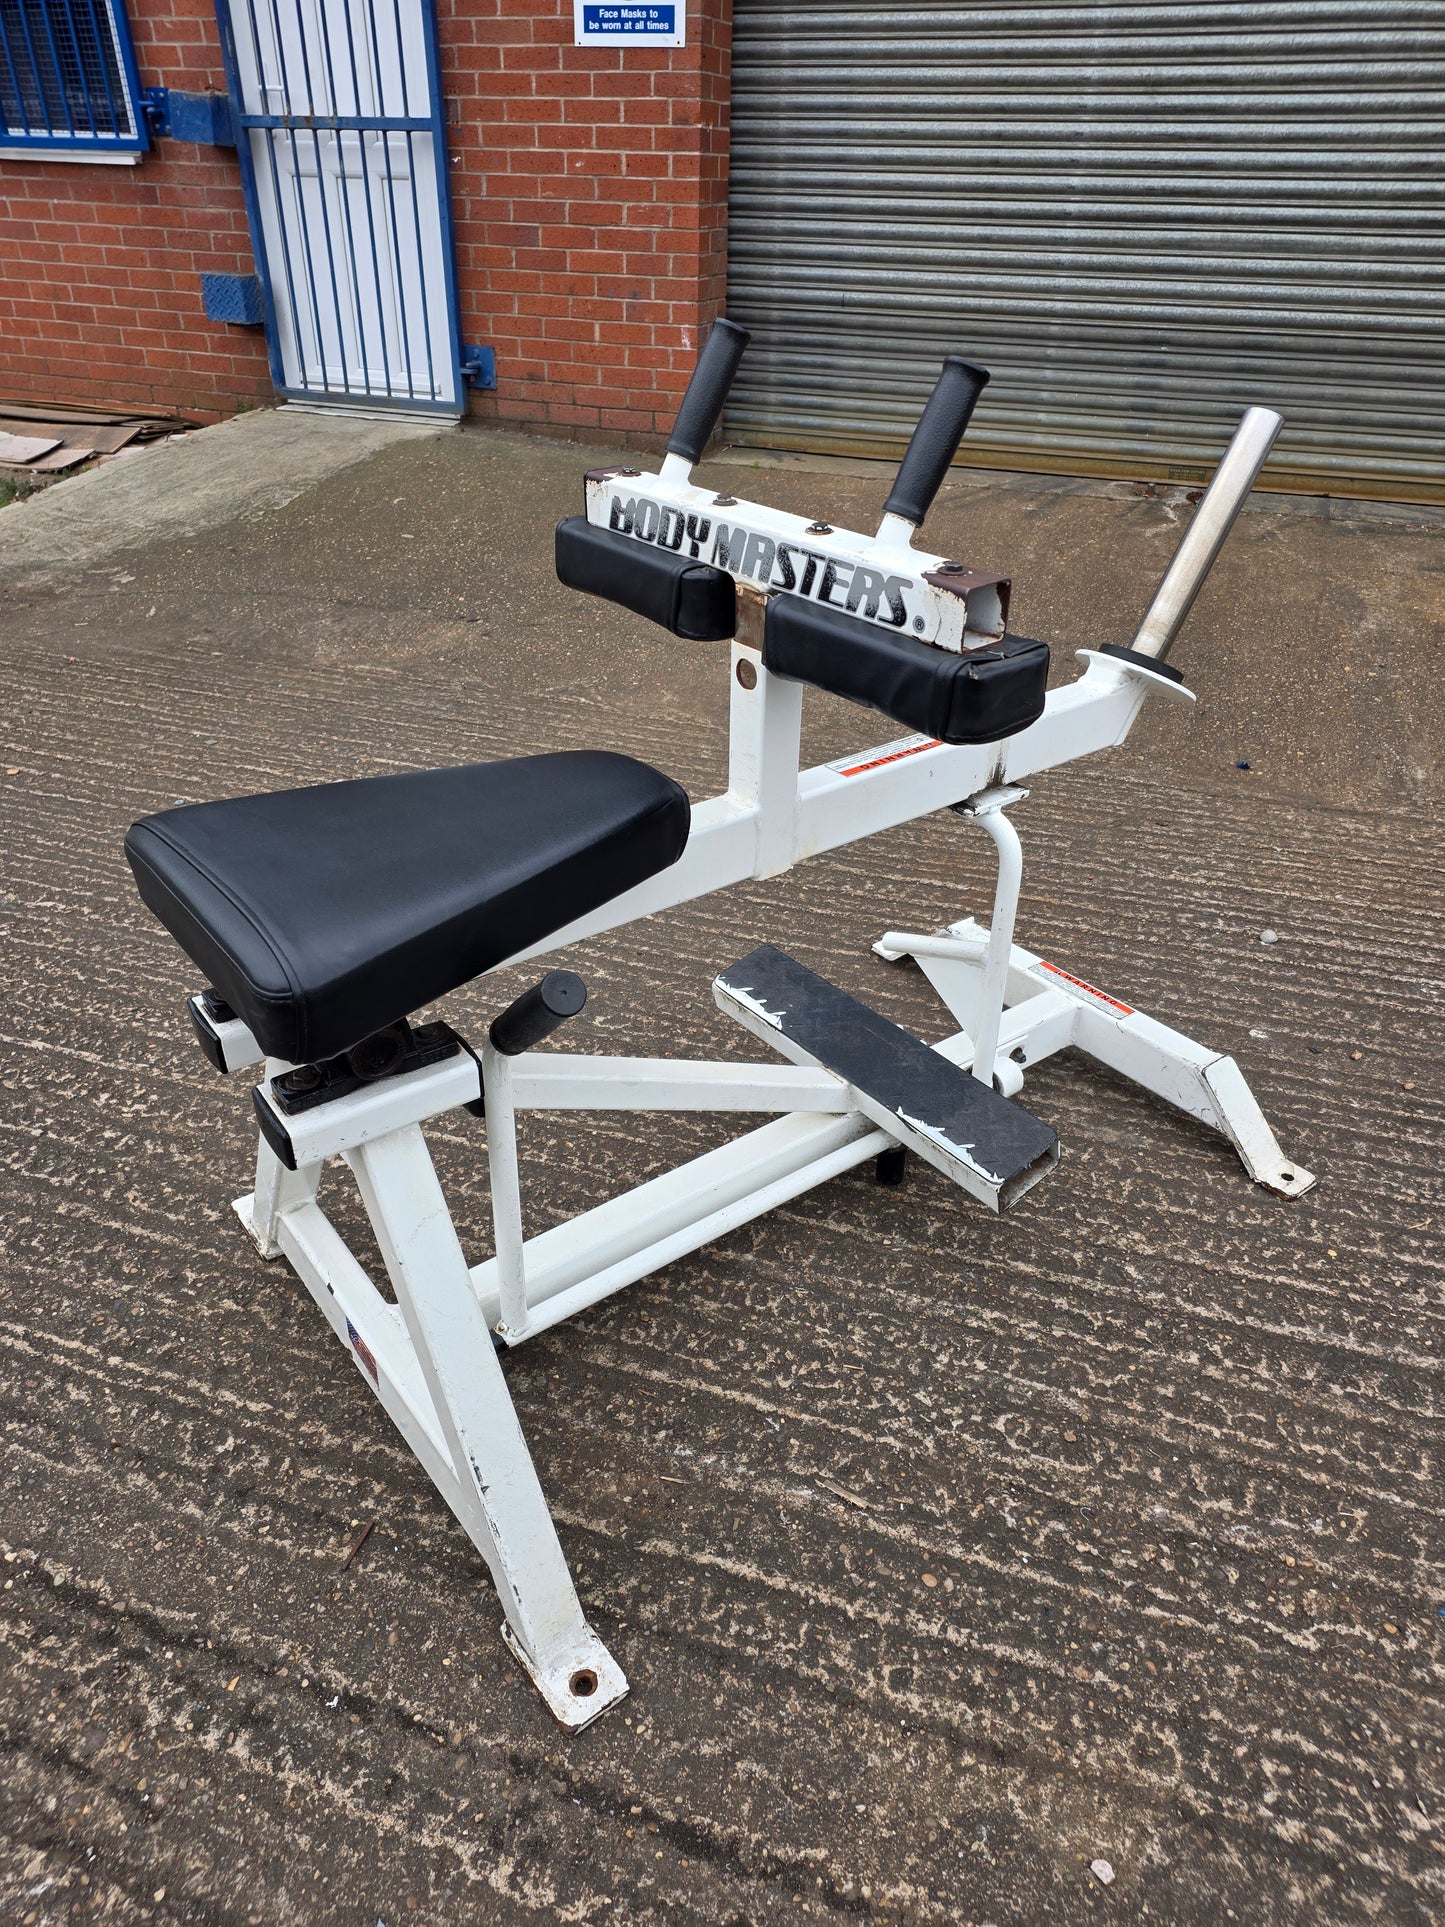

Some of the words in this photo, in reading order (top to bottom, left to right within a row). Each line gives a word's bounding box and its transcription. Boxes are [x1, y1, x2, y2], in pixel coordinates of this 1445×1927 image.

[599, 9, 618, 18] Face
[621, 9, 647, 18] Masks
[649, 9, 659, 18] to
[589, 20, 600, 30] be
[602, 22, 621, 30] worn
[623, 21, 633, 30] at
[635, 21, 645, 30] all
[647, 21, 669, 30] times
[859, 746, 924, 769] WARNING
[1064, 975, 1117, 1005] WARNING
